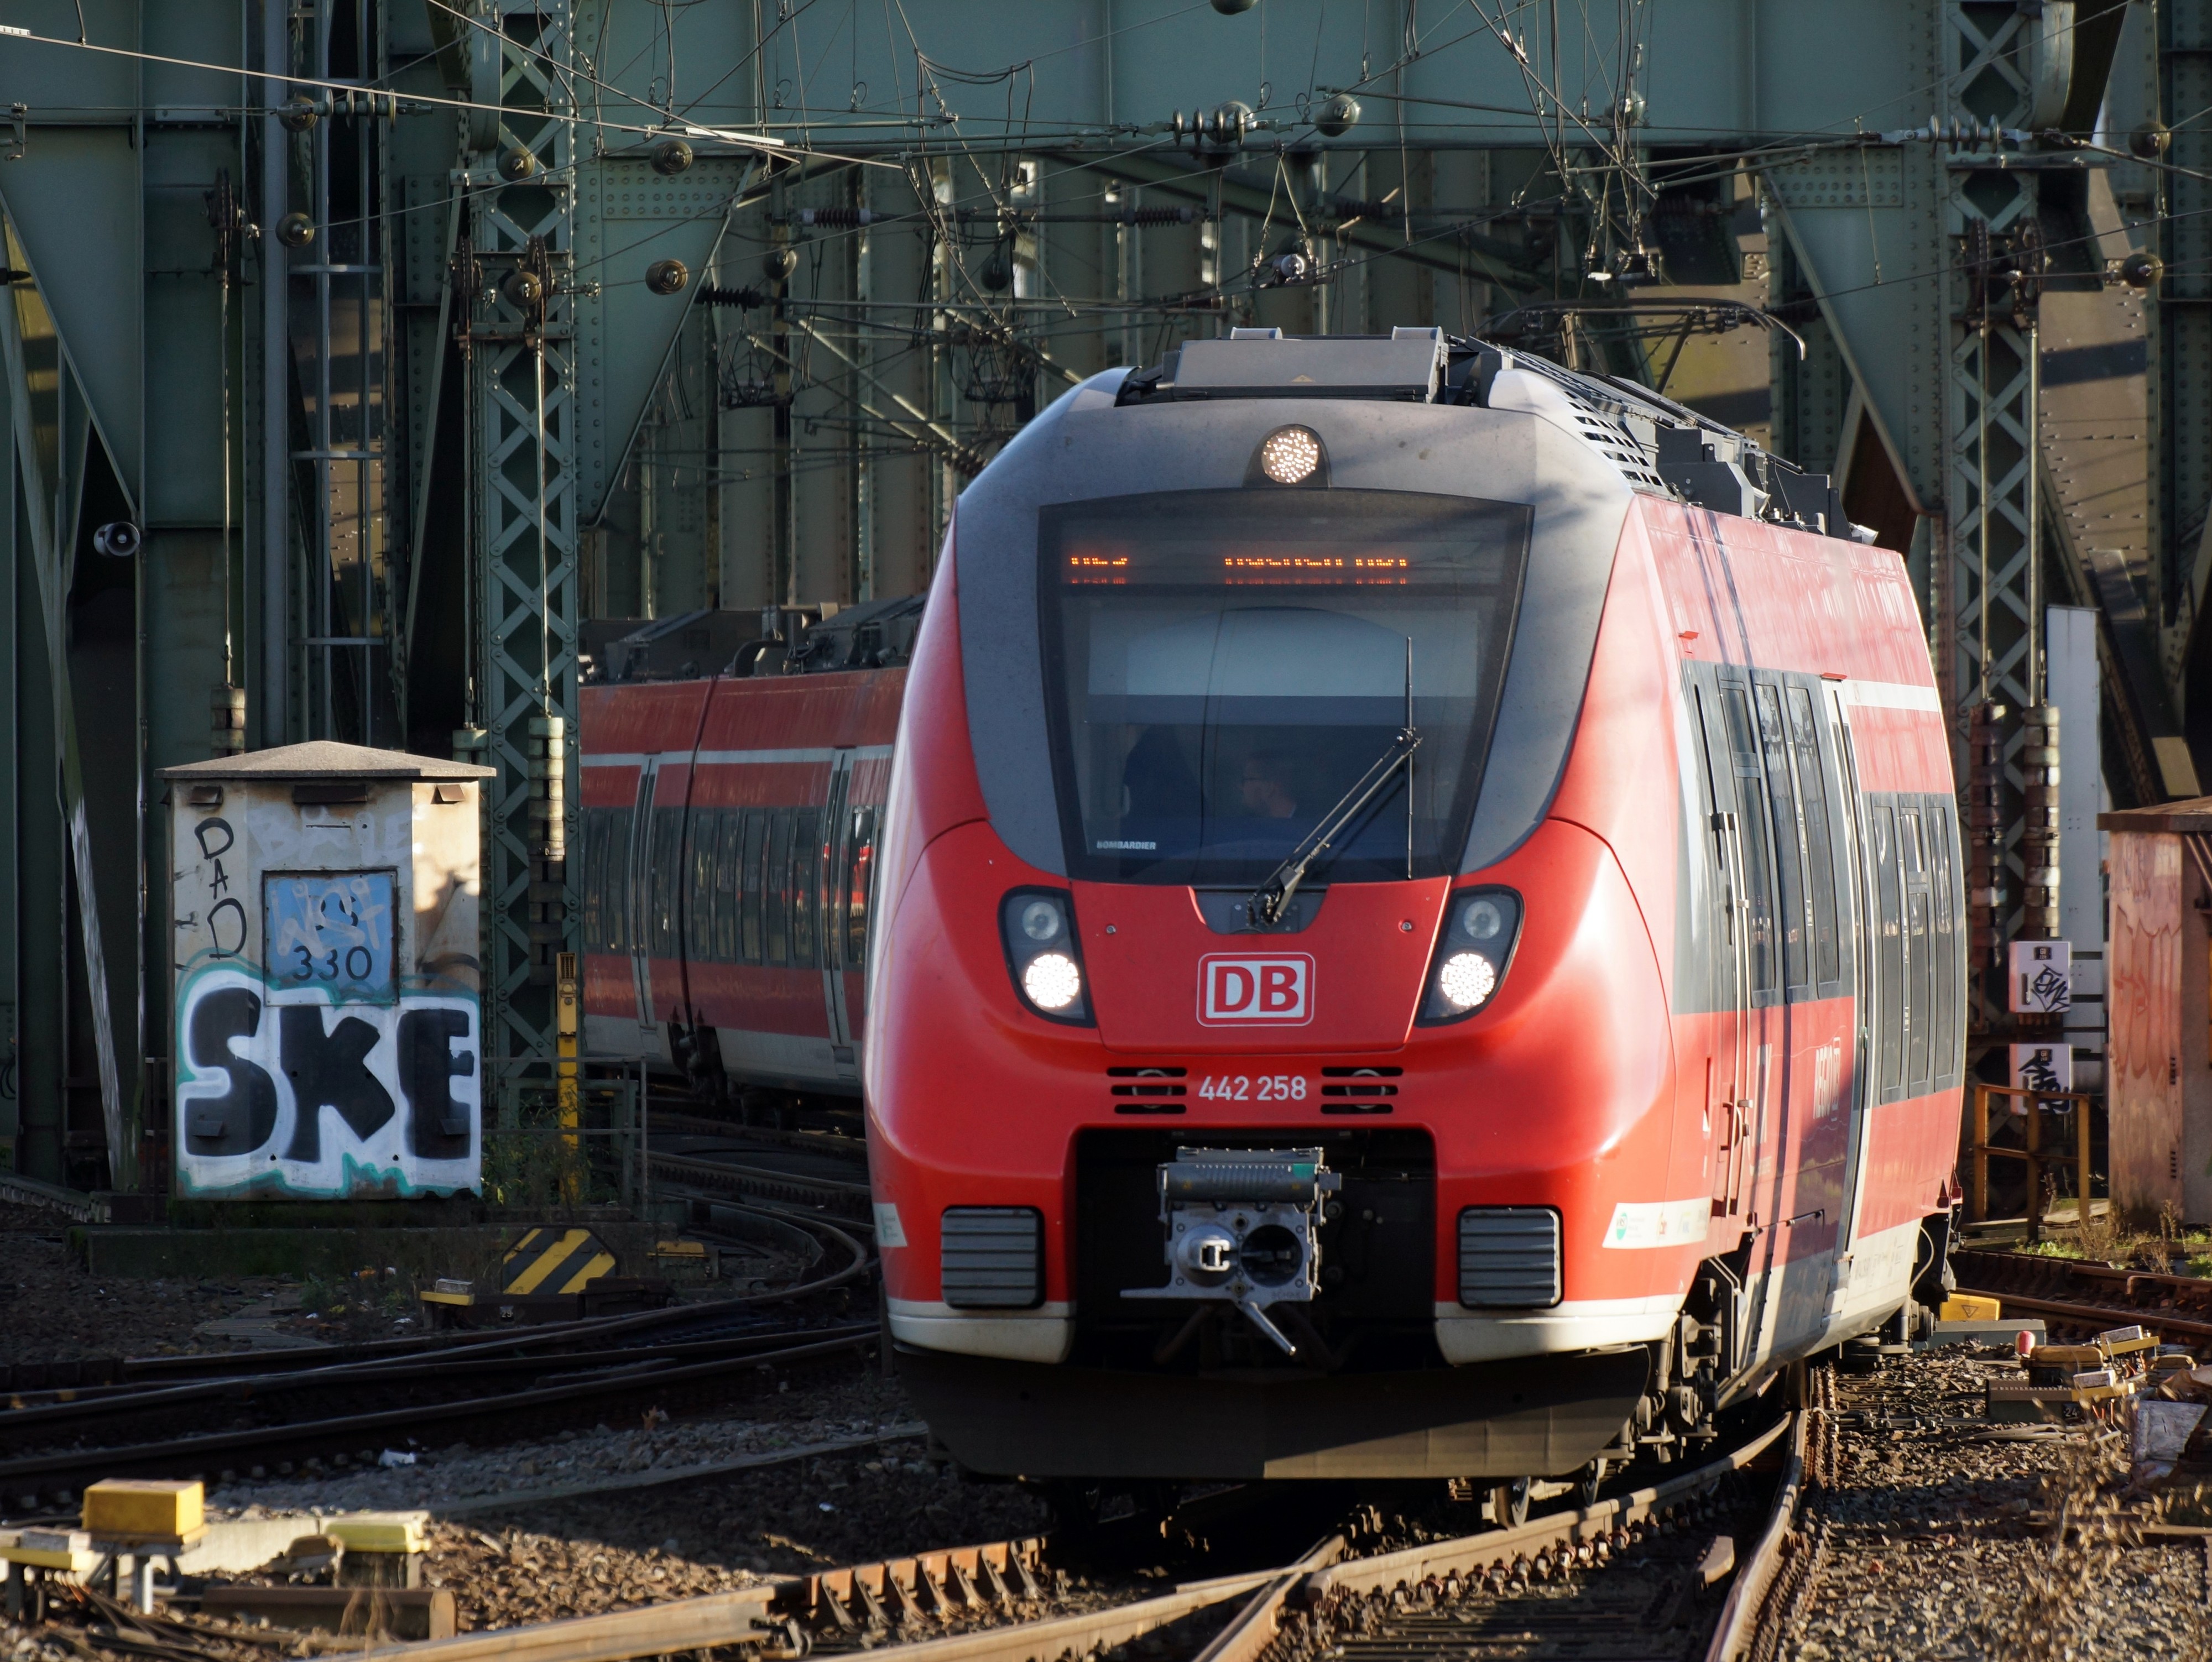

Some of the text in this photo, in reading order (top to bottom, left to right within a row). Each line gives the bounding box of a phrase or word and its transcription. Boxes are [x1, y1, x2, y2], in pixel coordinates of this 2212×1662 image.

[1096, 840, 1157, 850] BOMBARDIER
[194, 817, 247, 960] DAD
[292, 945, 373, 981] 330
[1214, 965, 1299, 1012] DB
[181, 985, 476, 1164] SKE
[1198, 1075, 1307, 1101] 442 258
[2065, 1408, 2078, 1418] 24
